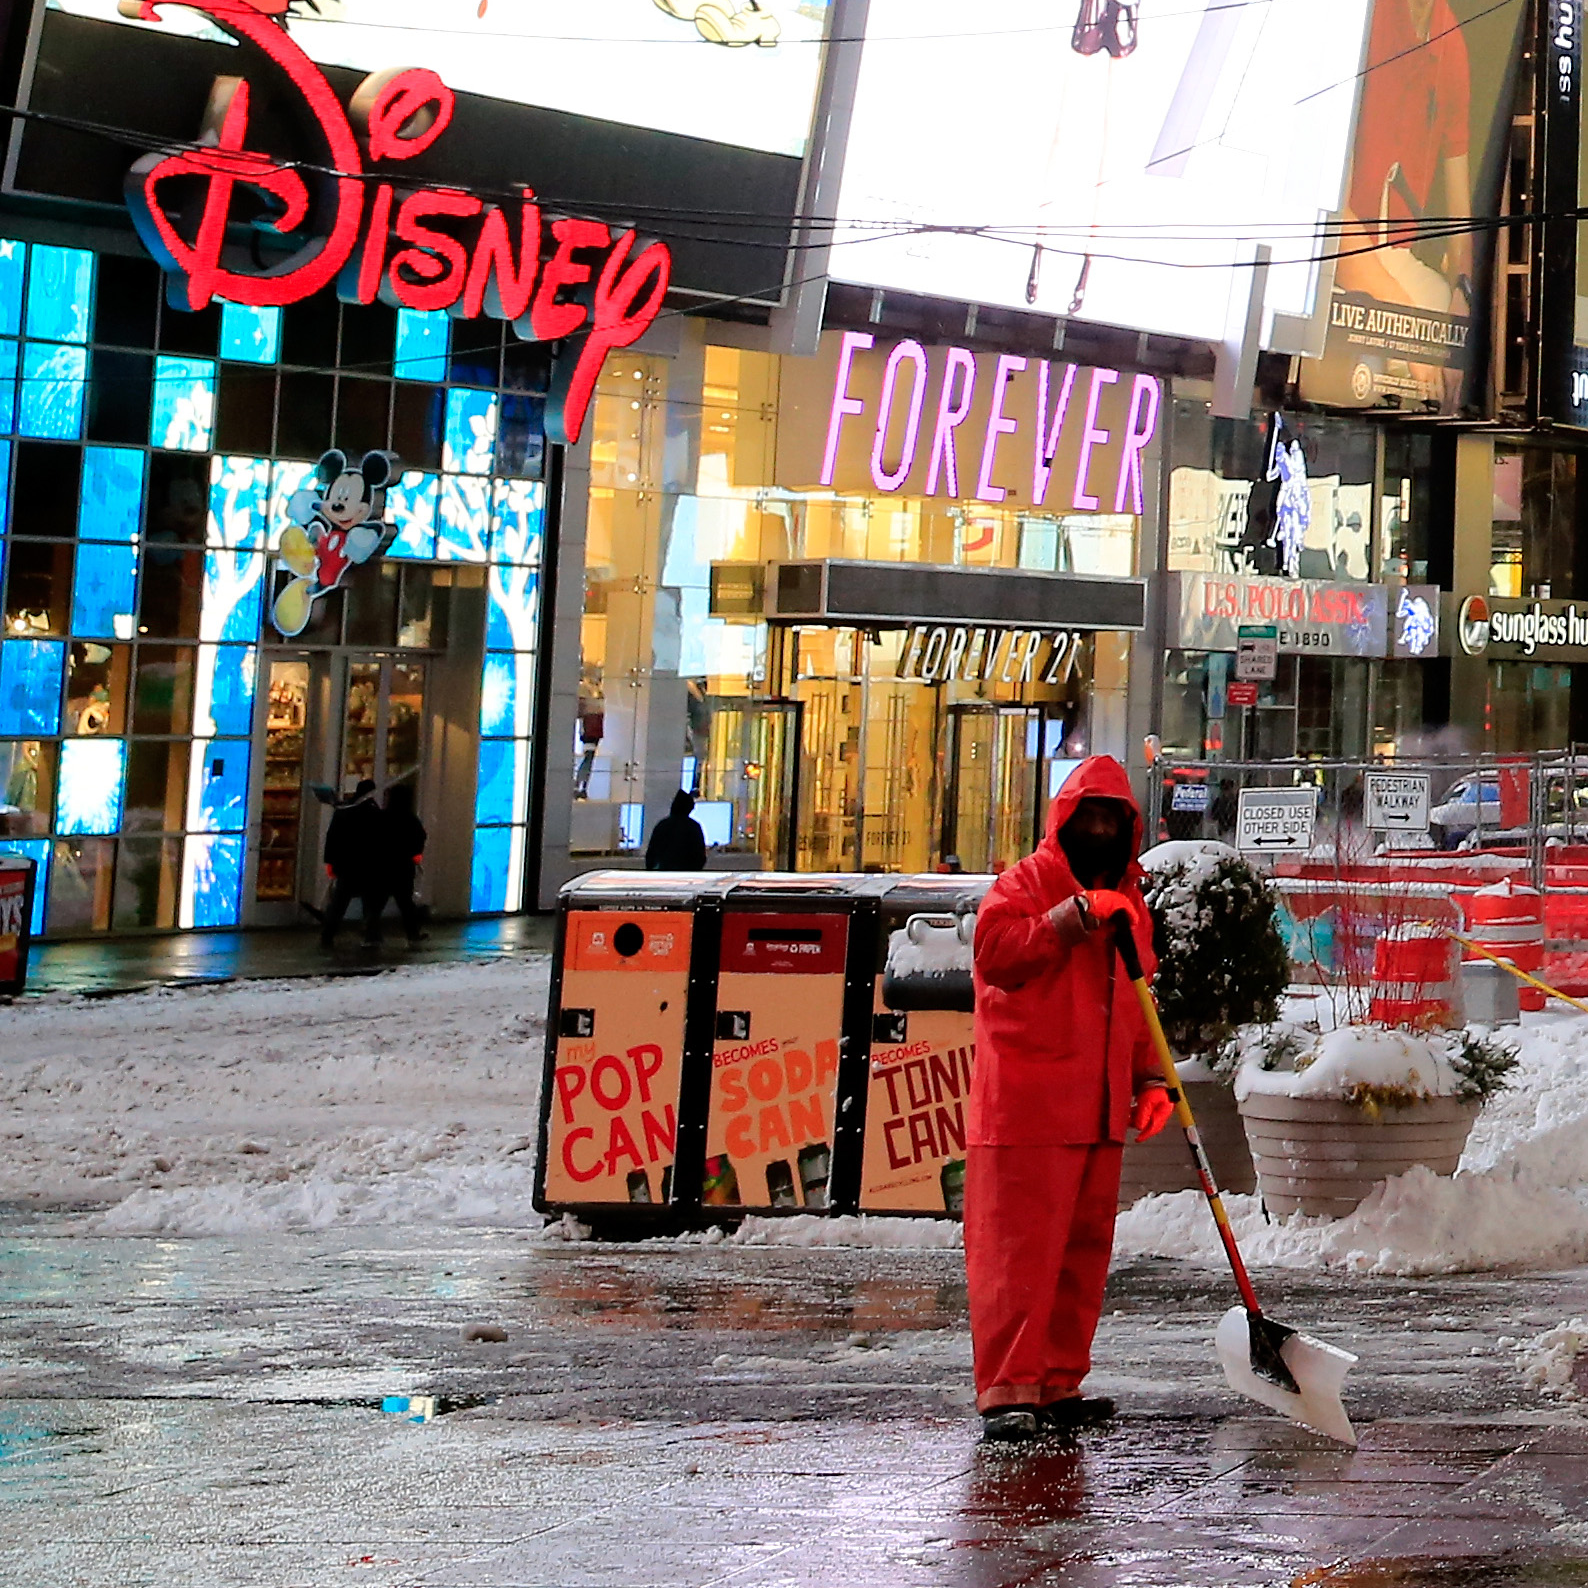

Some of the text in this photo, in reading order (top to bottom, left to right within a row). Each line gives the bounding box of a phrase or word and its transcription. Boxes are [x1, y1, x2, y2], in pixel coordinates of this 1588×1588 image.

[1331, 302, 1365, 330] LIVE
[1365, 308, 1469, 348] AUTHENTICALLY
[820, 331, 1161, 516] FOREVER
[1204, 581, 1242, 619] U.S.
[1247, 585, 1305, 622] POLO
[1295, 632, 1330, 647] 1890
[1491, 602, 1567, 655] sunglass
[902, 627, 1041, 685] FOREVER
[1370, 778, 1425, 792] PEDESTRIAN
[1376, 796, 1421, 809] WALKWAY
[1243, 806, 1311, 819] CLOSED USE
[1243, 821, 1307, 834] OTHER SIDE
[713, 1038, 779, 1068] BECOMES
[719, 1038, 838, 1112] SODA
[873, 1043, 976, 1116] TONI
[555, 1043, 664, 1124] POP
[562, 1104, 678, 1183] CAN
[725, 1092, 827, 1159] CAN
[883, 1101, 968, 1170] CAN
